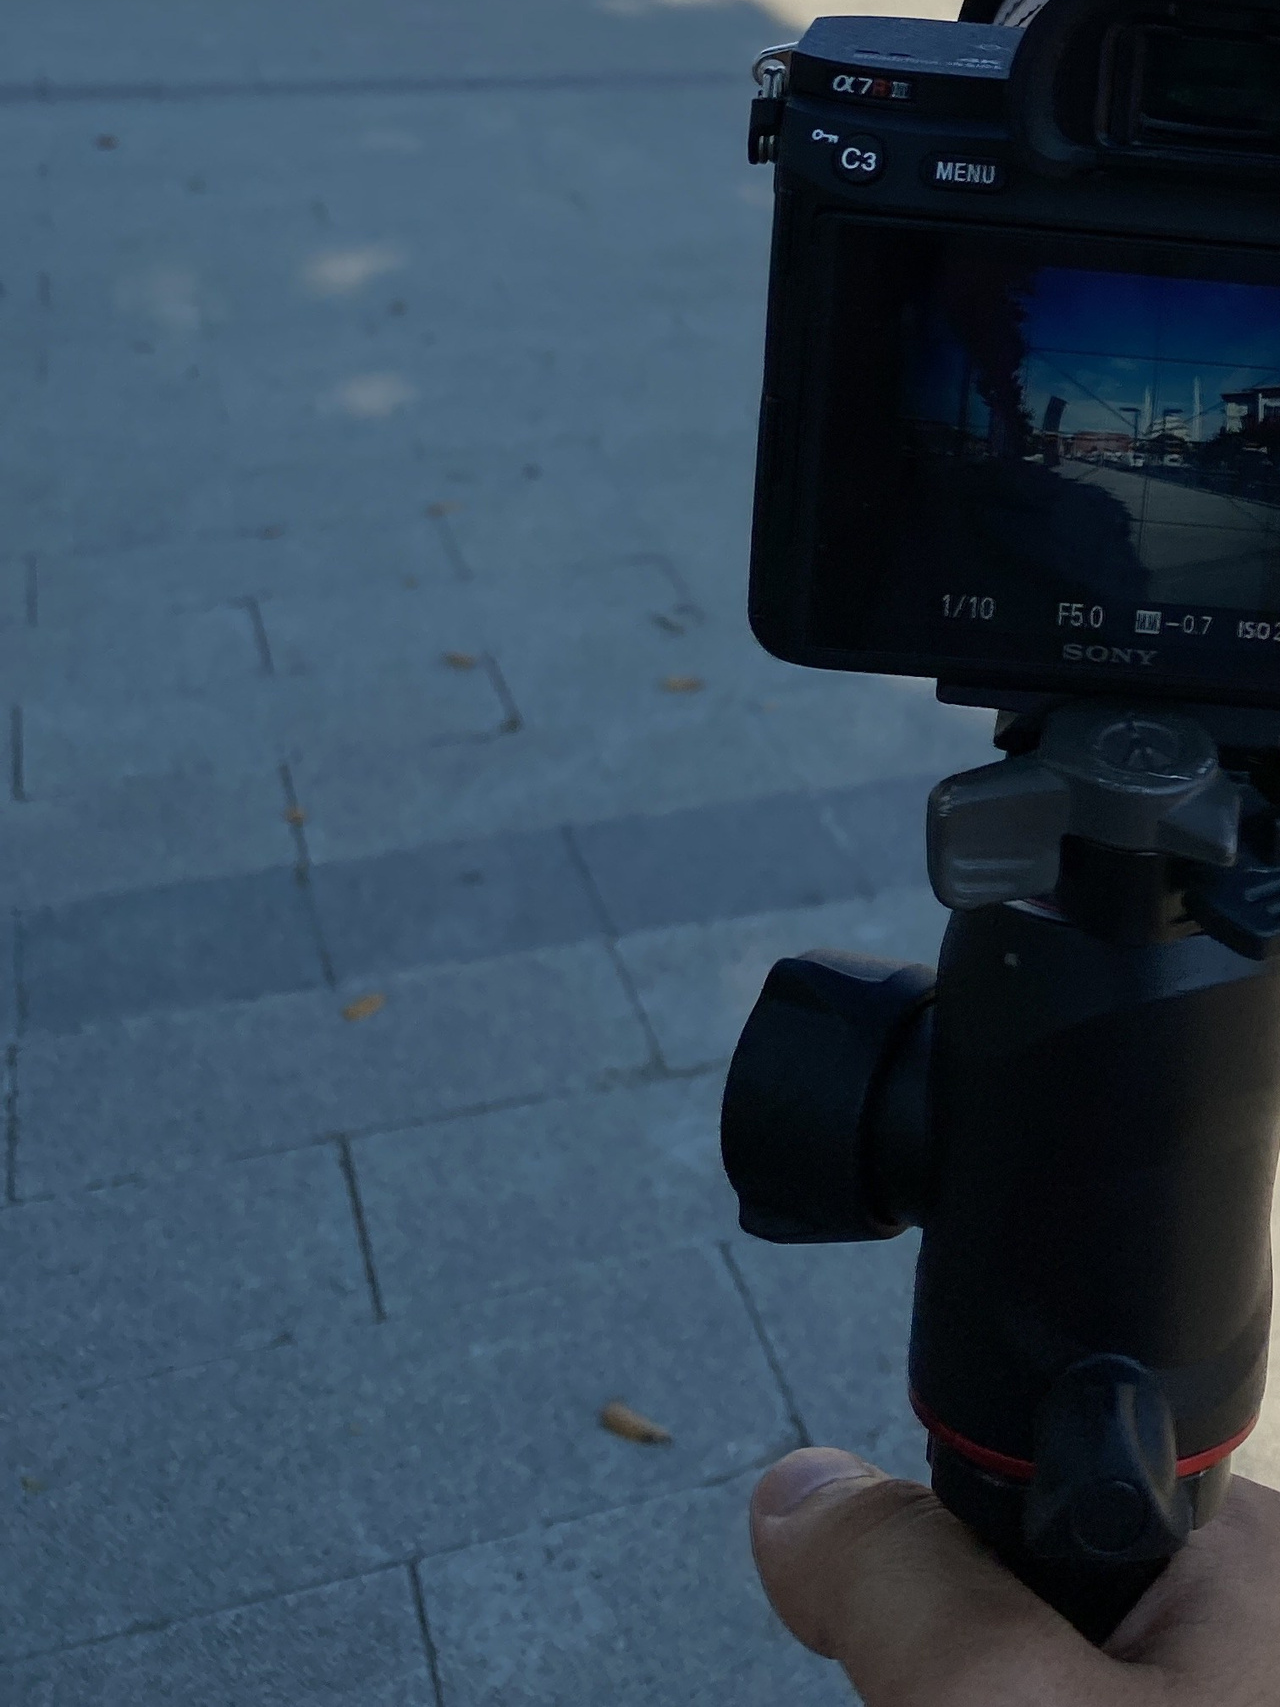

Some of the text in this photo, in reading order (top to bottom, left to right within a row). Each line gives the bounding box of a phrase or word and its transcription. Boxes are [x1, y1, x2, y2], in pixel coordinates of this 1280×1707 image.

[841, 147, 877, 172] C3
[935, 160, 996, 184] MENU
[941, 594, 996, 620] 1/10
[1057, 602, 1105, 629] F5.0
[1062, 643, 1159, 667] SONY
